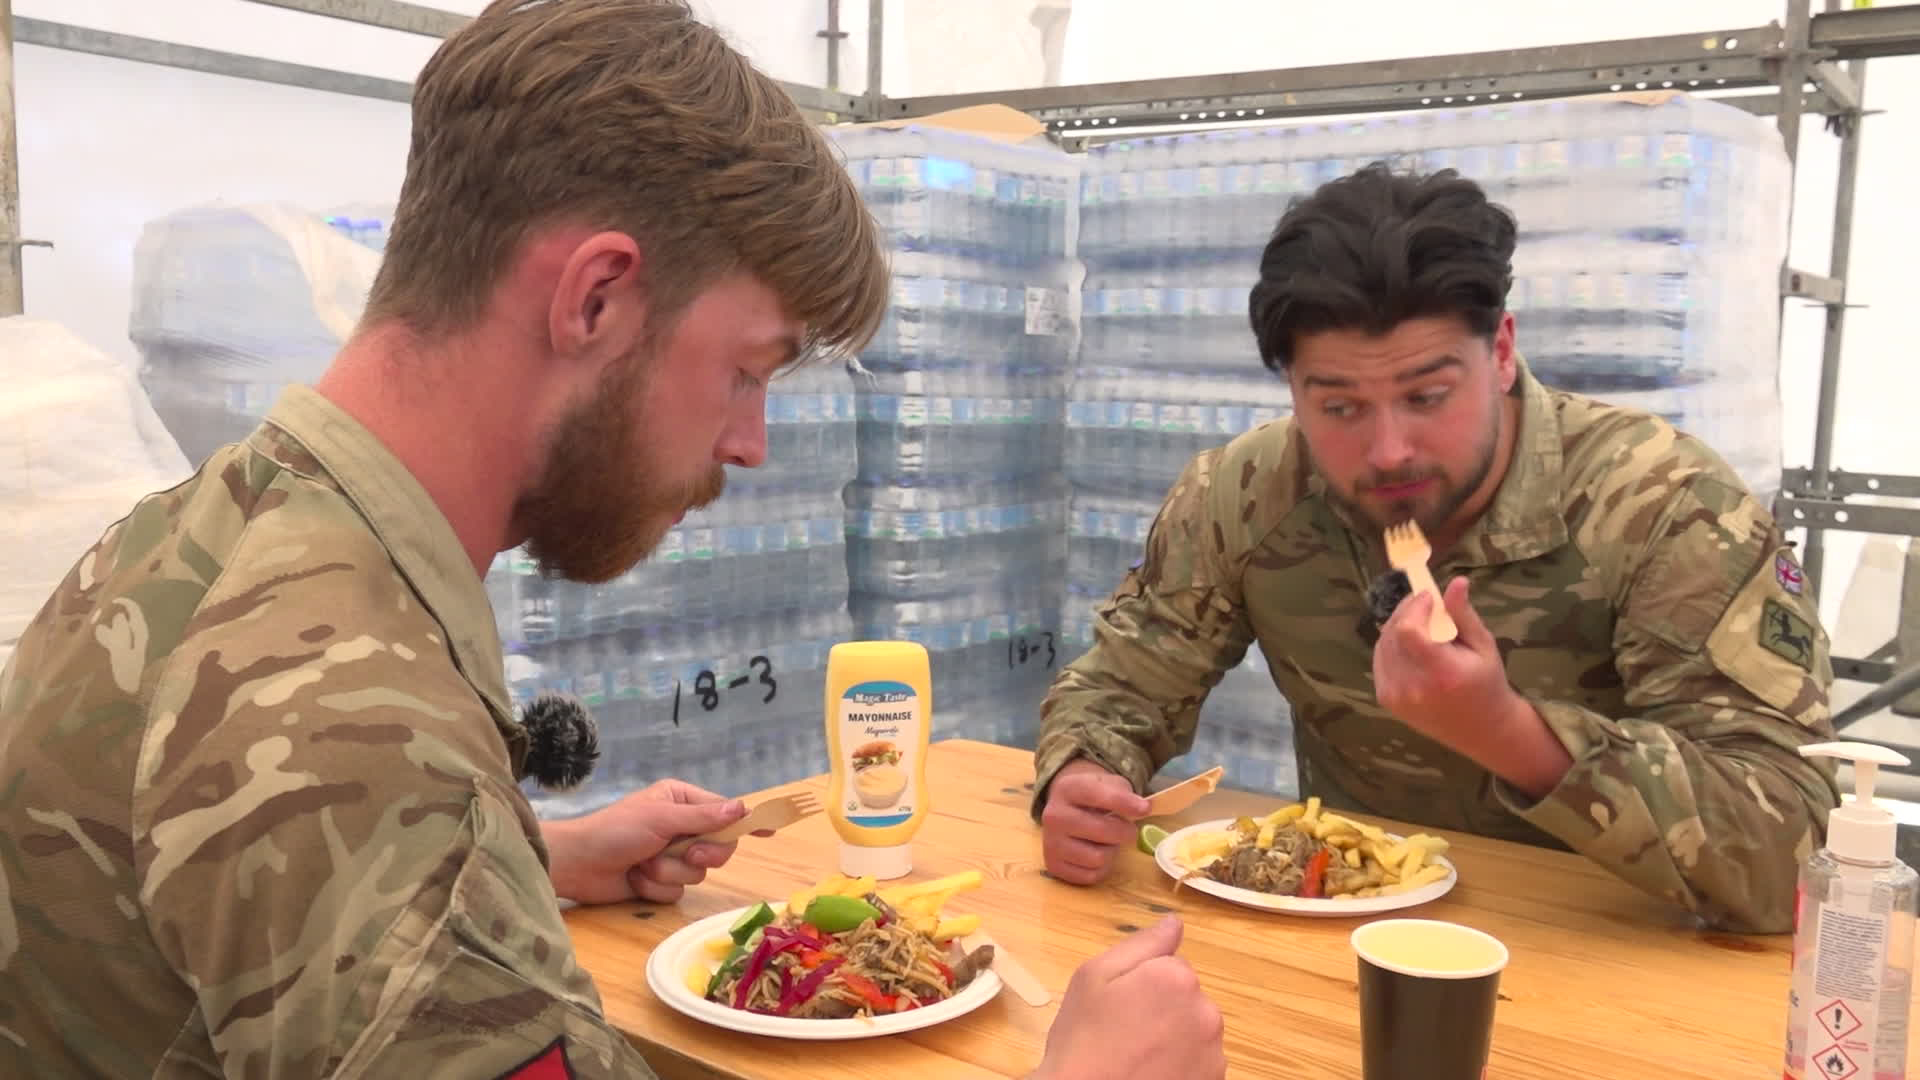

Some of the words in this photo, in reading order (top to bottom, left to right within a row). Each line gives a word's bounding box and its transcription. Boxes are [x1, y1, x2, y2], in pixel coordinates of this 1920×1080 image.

[1008, 631, 1056, 670] 18-3
[672, 655, 776, 726] 18-3
[855, 693, 881, 705] Magic
[884, 692, 907, 702] Taste
[848, 711, 912, 722] MAYONNAISE
